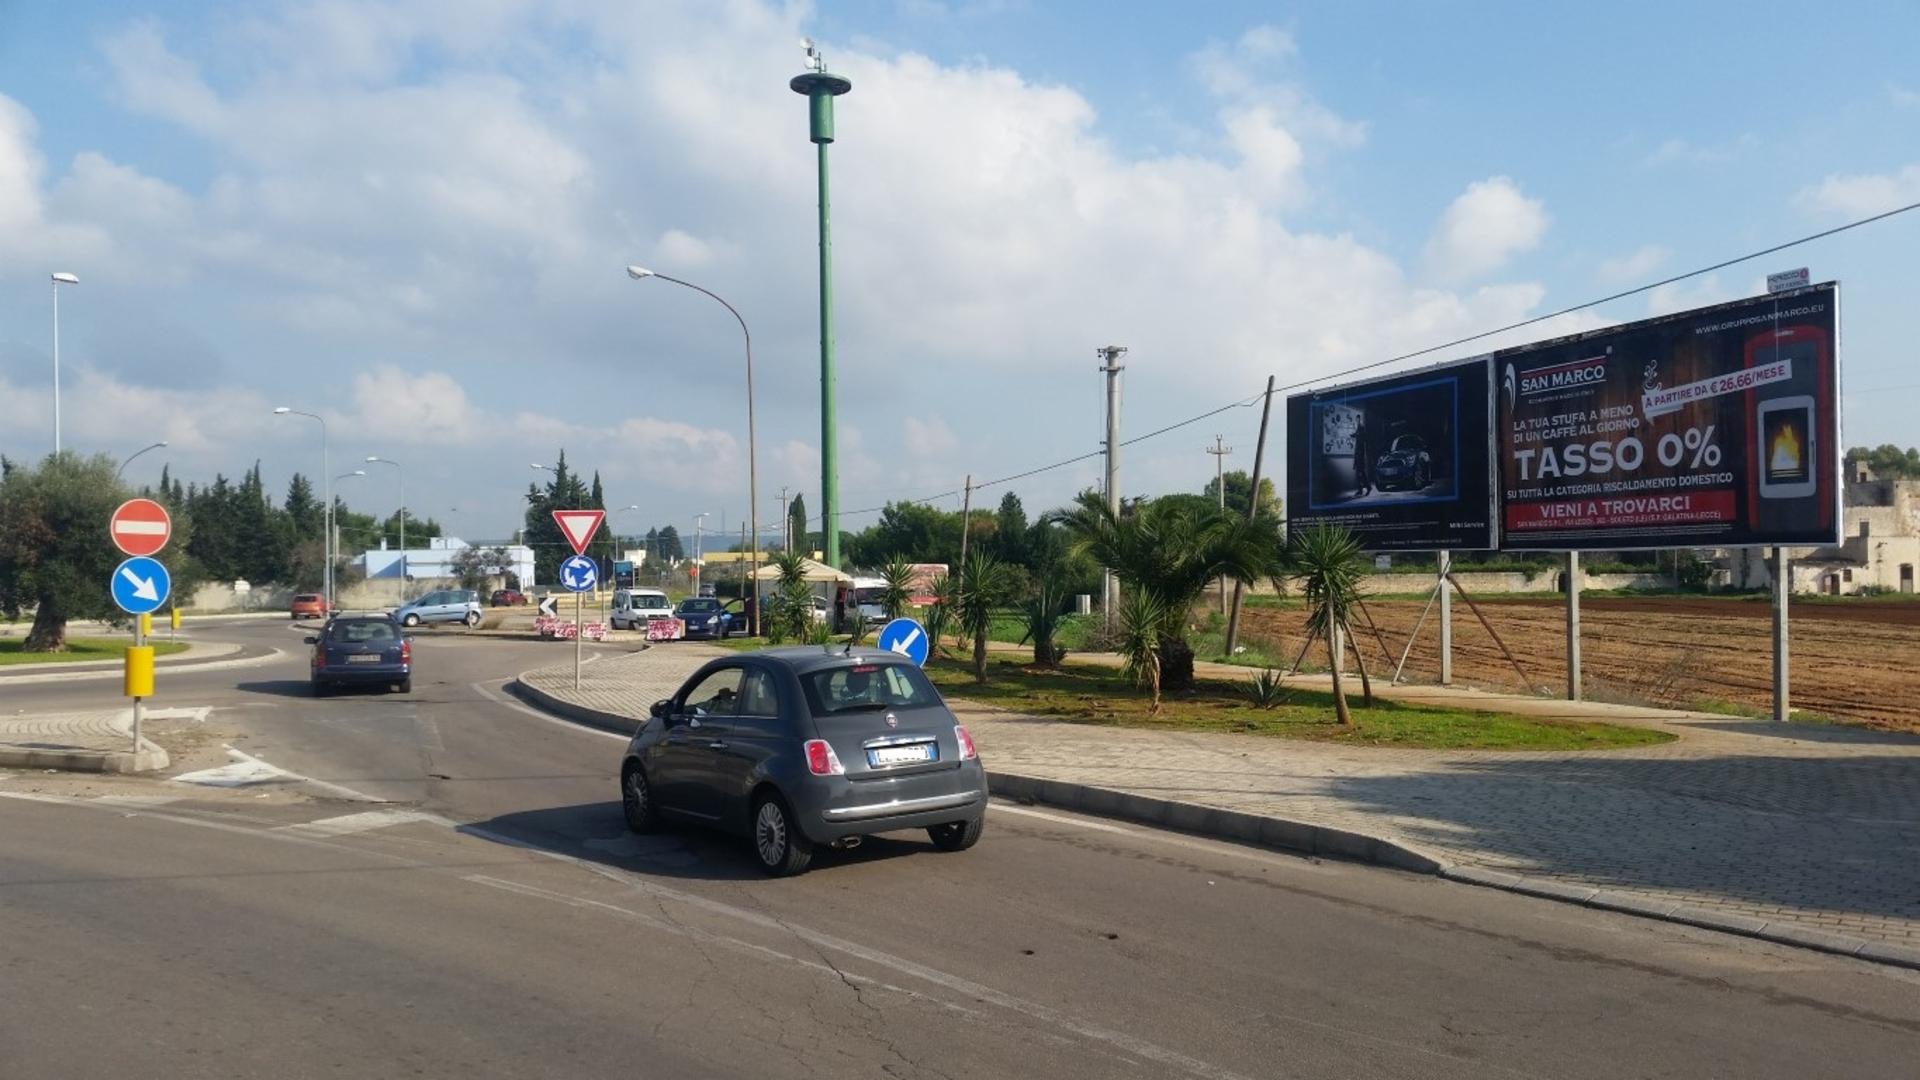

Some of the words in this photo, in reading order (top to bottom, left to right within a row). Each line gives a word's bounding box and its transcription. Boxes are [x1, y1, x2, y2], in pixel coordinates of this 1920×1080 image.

[1521, 375, 1549, 391] SAN
[1552, 365, 1605, 386] MARCO
[1645, 395, 1652, 408] A
[1655, 389, 1692, 406] PARTIRE
[1694, 386, 1708, 396] DA
[1513, 421, 1527, 431] LA
[1529, 417, 1550, 429] TUA
[1551, 412, 1586, 426] STUFA
[1589, 410, 1598, 420] A
[1600, 404, 1634, 419] MENO
[1513, 433, 1523, 444] DI
[1525, 431, 1540, 442] UN
[1579, 424, 1595, 435] AL
[1596, 417, 1640, 433] GIORNO
[1514, 437, 1644, 481] TASSO
[1657, 425, 1722, 469] 0%
[1507, 490, 1517, 499] SU
[1519, 487, 1542, 498] TUTTA
[1543, 486, 1555, 497] LA
[1556, 483, 1601, 496] CATEGORIA
[1602, 476, 1677, 492] RISCALDAMENTO
[1679, 472, 1733, 487] DOMESTICO
[1540, 503, 1582, 518] VIENI
[1587, 502, 1598, 515] A
[1602, 496, 1690, 515] TROVARCI
